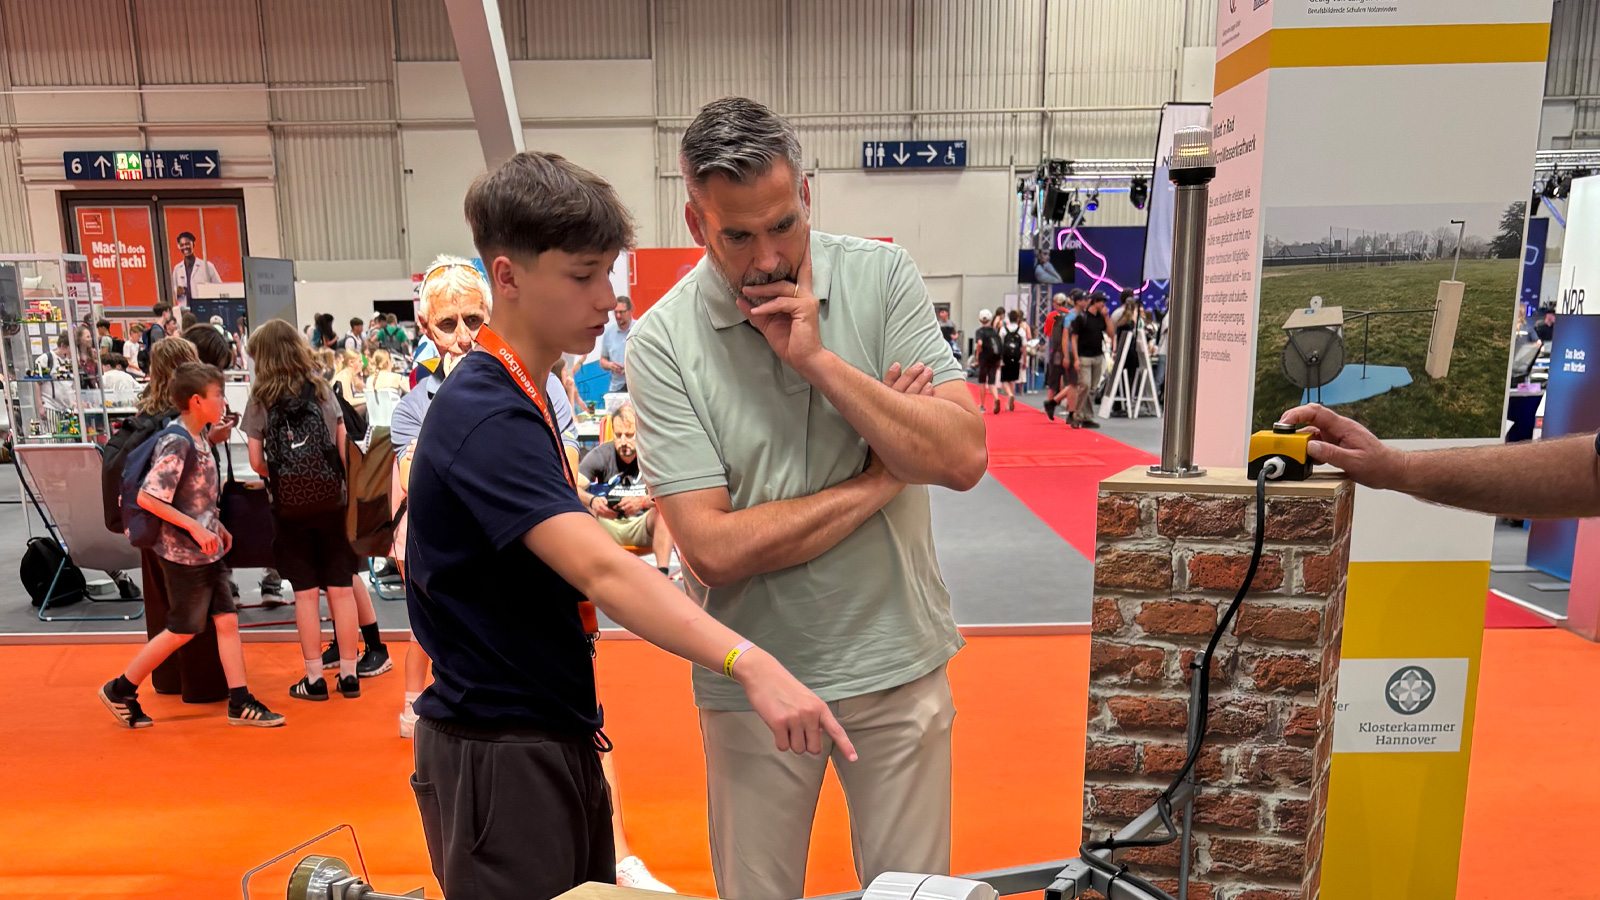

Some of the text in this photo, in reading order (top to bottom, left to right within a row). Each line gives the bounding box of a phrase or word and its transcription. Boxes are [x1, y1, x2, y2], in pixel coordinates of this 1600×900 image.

[71, 153, 190, 174] 6 WC
[91, 241, 145, 254] Mach doch
[92, 255, 147, 268] einfach!
[1562, 288, 1585, 315] NDR
[499, 348, 537, 398] IdeenExpo
[1358, 722, 1455, 733] Klosterkammer
[1375, 735, 1437, 745] Hannover
